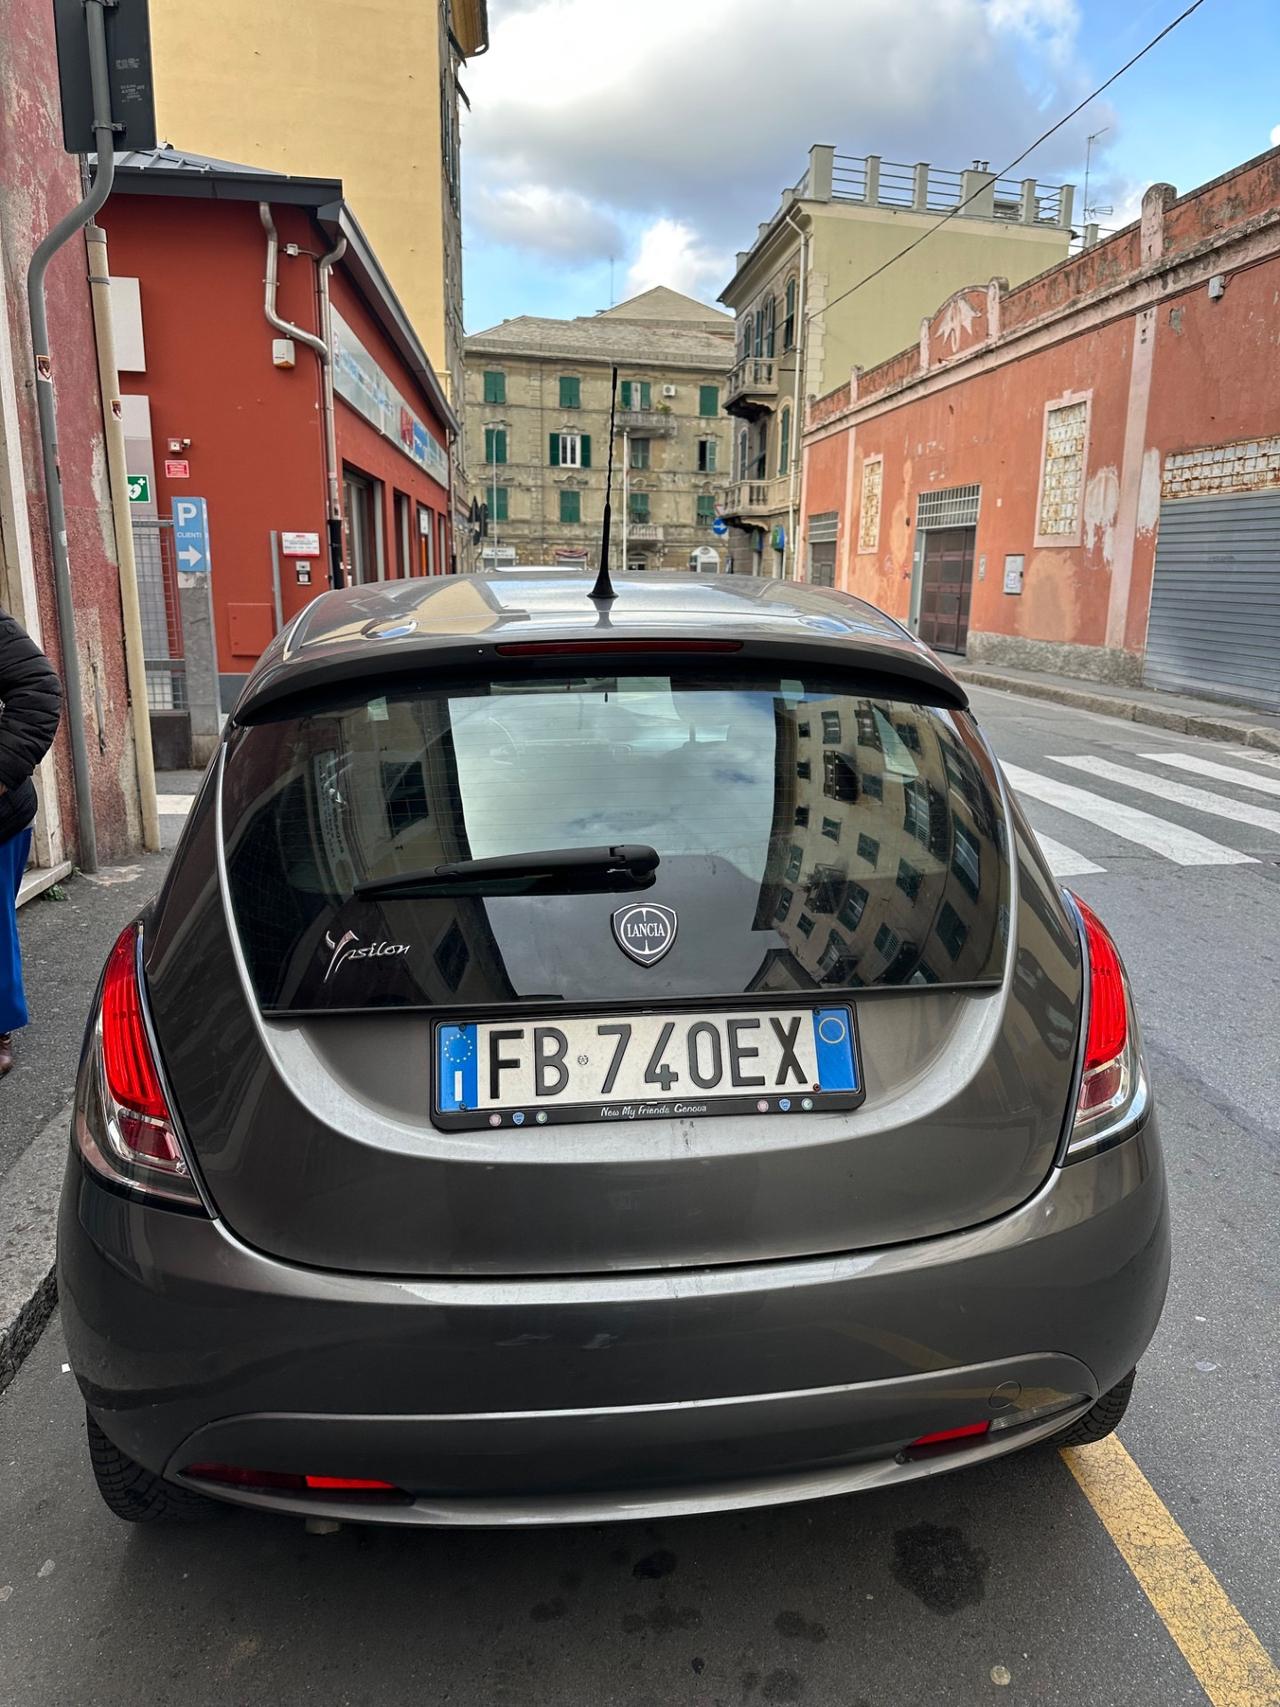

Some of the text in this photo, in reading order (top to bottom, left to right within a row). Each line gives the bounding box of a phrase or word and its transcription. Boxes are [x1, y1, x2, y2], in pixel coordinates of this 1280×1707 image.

[177, 502, 197, 526] P
[627, 922, 665, 937] LANCIA
[323, 930, 411, 983] Ypsilon
[622, 1106, 636, 1119] My
[674, 1103, 707, 1113] Genova
